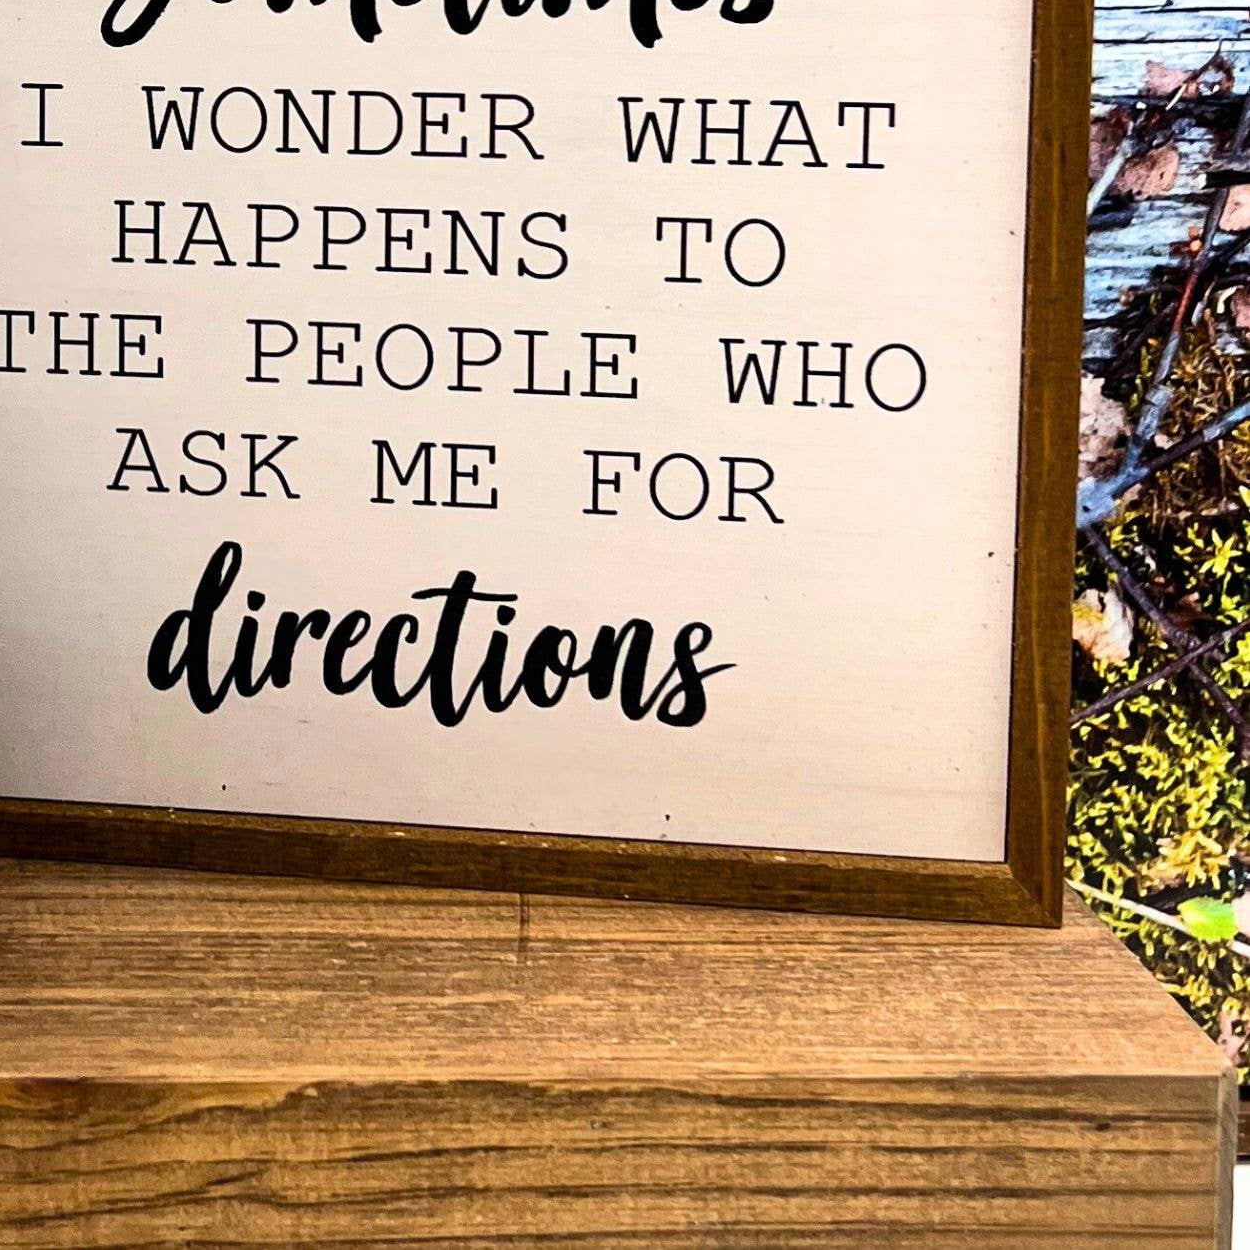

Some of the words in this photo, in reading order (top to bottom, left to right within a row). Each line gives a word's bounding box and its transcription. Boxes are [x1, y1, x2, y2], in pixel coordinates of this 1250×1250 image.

[20, 82, 64, 147] I
[141, 85, 545, 160] WONDER
[617, 96, 896, 170] WHAT
[111, 199, 569, 280] HAPPENS
[656, 216, 787, 288] TO
[245, 318, 638, 400] PEOPLE
[718, 338, 928, 412] WHO
[106, 427, 301, 500] ASK
[369, 439, 498, 510] ME
[582, 449, 785, 525] FOR
[146, 540, 737, 728] directions
